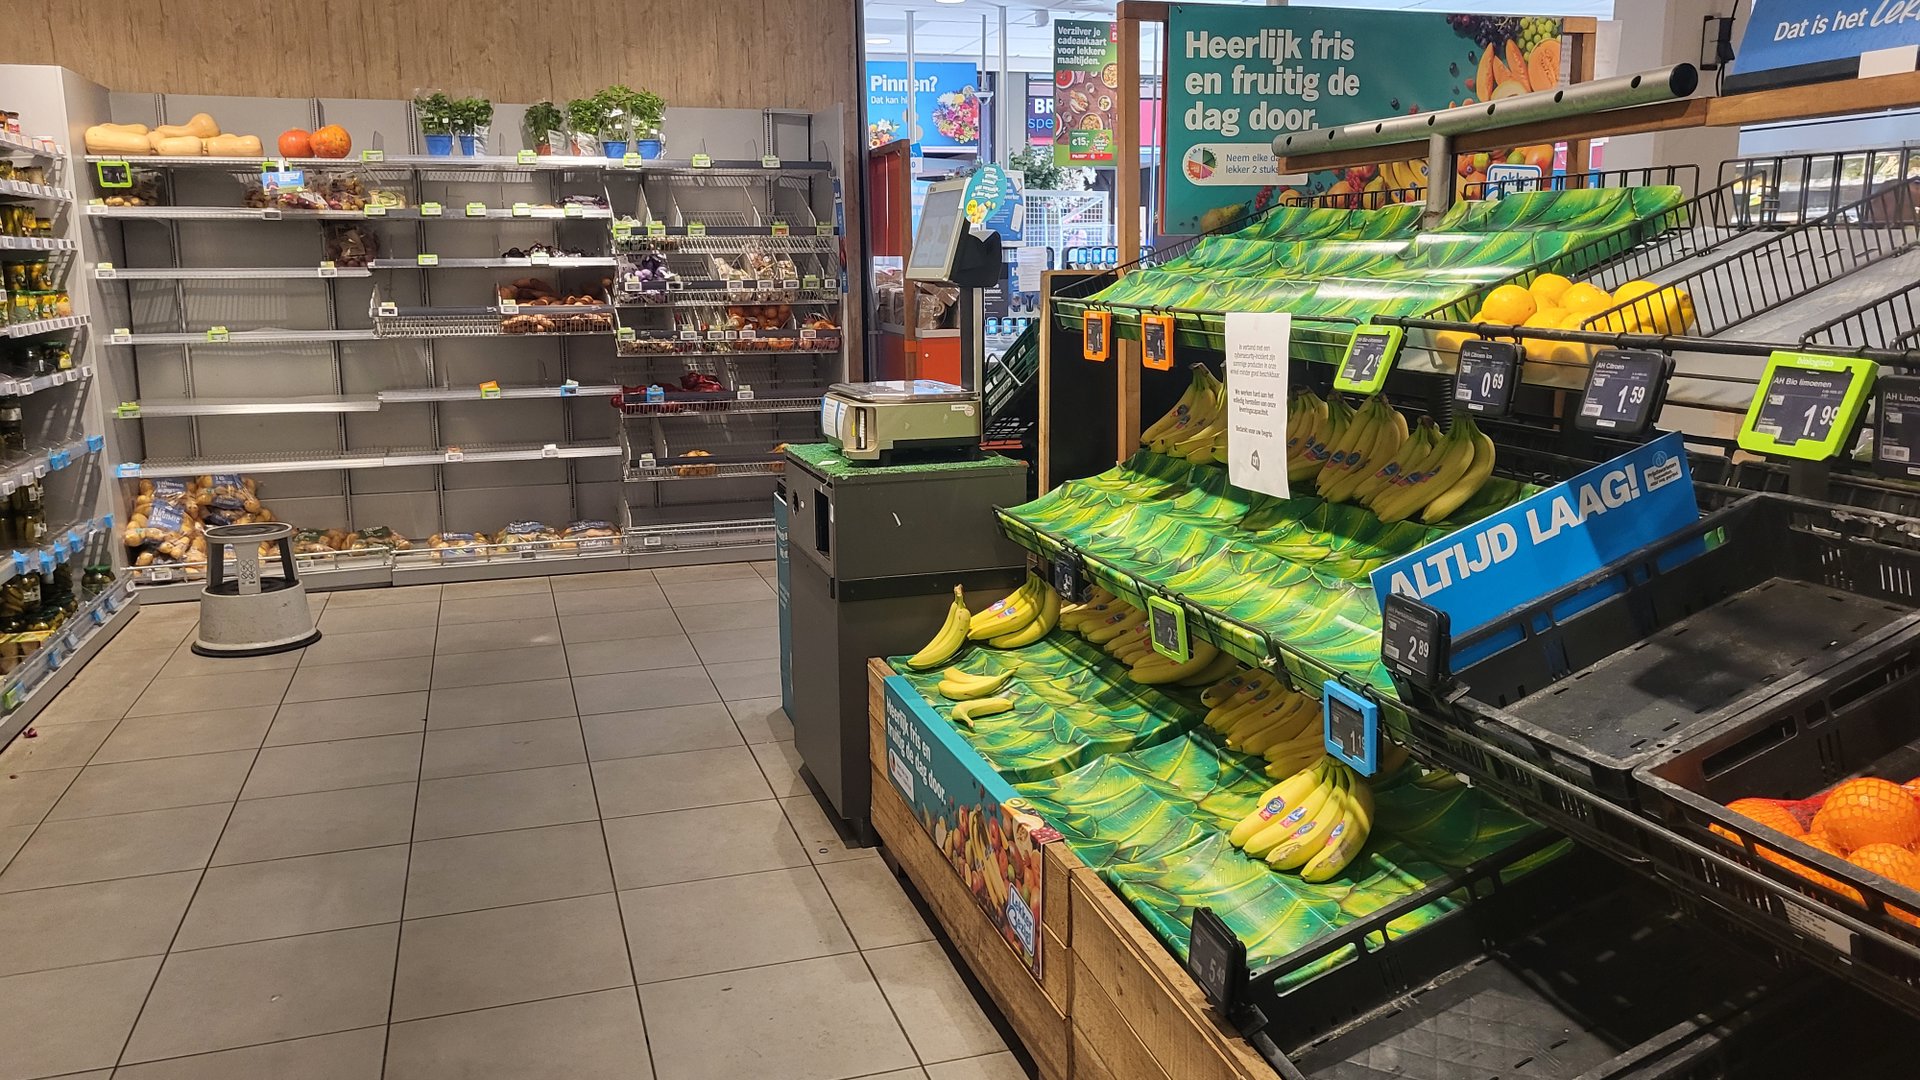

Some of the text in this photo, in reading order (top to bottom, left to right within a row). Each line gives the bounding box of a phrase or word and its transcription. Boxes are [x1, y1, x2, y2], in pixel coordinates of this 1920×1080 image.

[1773, 18, 1809, 41] Dat
[1810, 14, 1829, 35] is
[1831, 8, 1869, 32] het
[1057, 26, 1101, 38] Verzilver je
[1057, 36, 1107, 46] cadeaukaart
[1057, 46, 1106, 56] voor lekkere
[1185, 29, 1355, 66] Heerlijk fris
[1057, 55, 1101, 67] maaltijden.
[870, 74, 938, 92] Pinnen?
[1185, 64, 1361, 102] en fruitig de
[871, 96, 884, 104] Dat
[885, 96, 899, 104] kan
[1184, 101, 1319, 137] dag door.
[1226, 154, 1250, 162] Neem
[1252, 154, 1268, 162] elke
[1225, 165, 1250, 174] lekker
[1252, 165, 1257, 174] 2
[1785, 378, 1798, 386] Bio
[1886, 392, 1898, 400] AH
[1390, 463, 1641, 601] ALTIJD LAAG!
[886, 695, 931, 762] Heerlijk fris en
[905, 741, 914, 765] de
[915, 752, 928, 786] dag
[928, 769, 947, 806] door.
